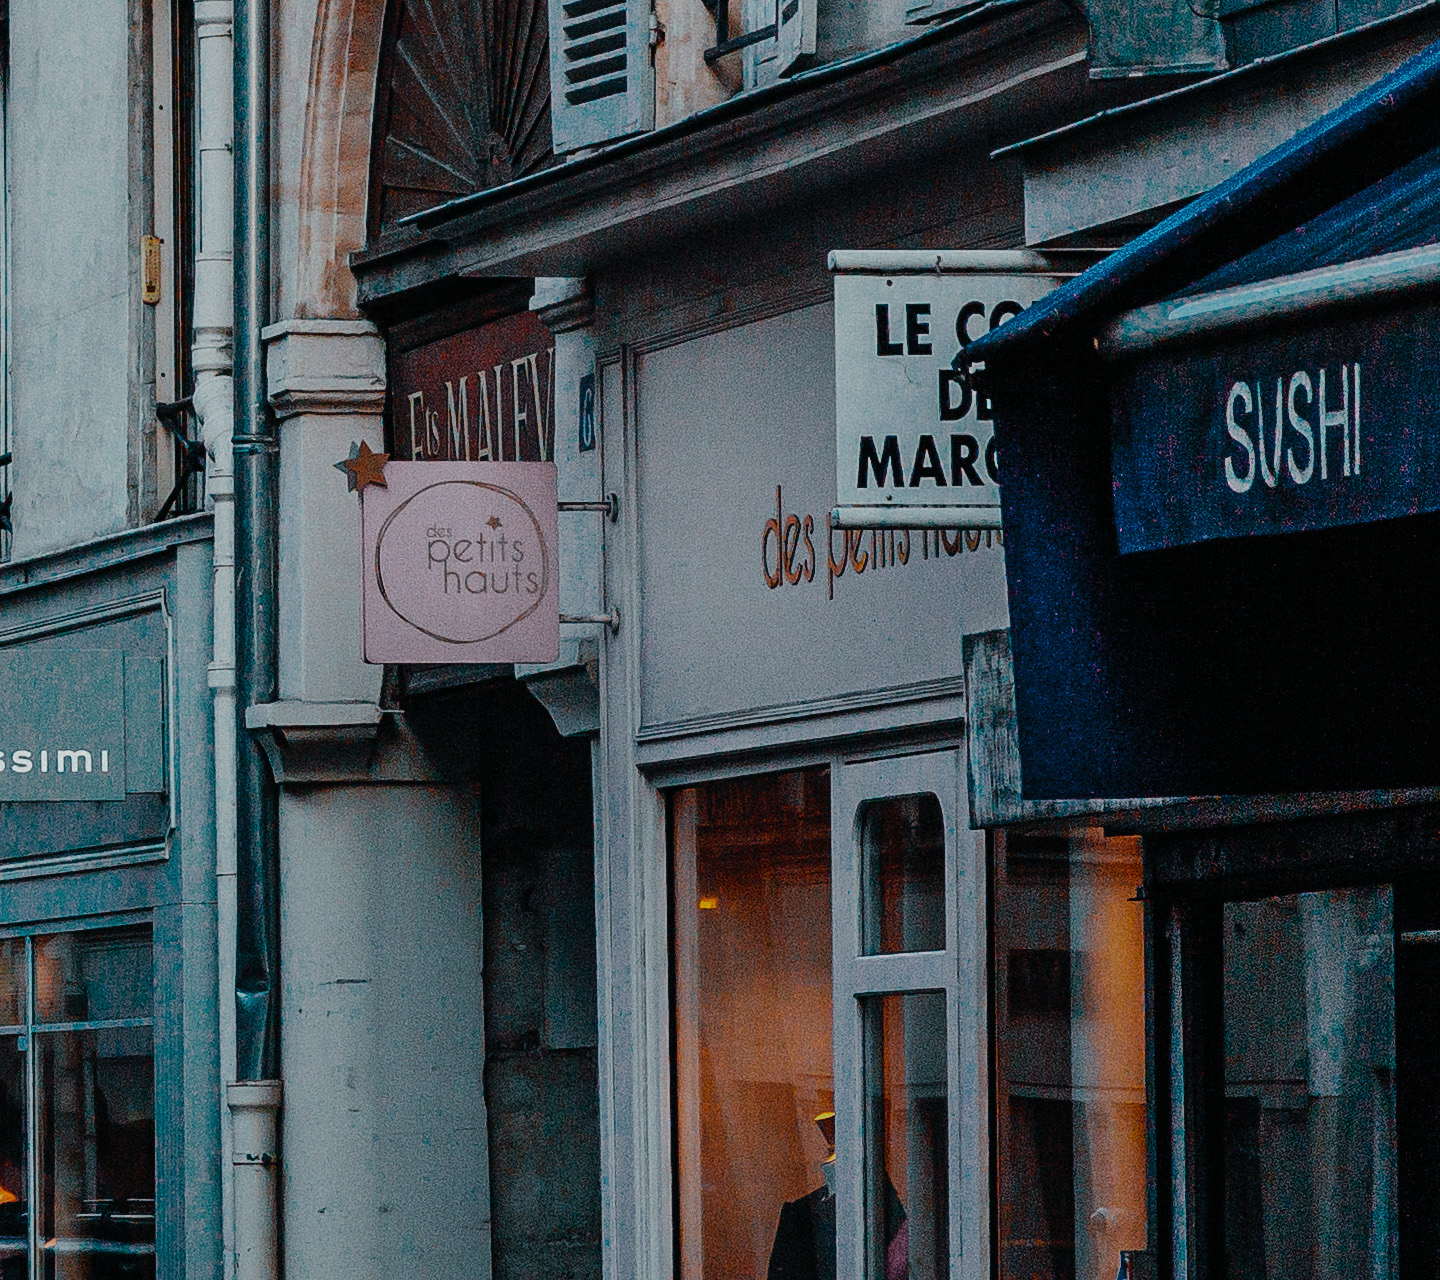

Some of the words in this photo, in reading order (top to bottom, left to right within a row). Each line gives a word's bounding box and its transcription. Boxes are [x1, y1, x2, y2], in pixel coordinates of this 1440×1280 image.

[875, 303, 933, 356] LE
[1224, 362, 1361, 494] SUSHI
[426, 523, 453, 538] des
[428, 532, 525, 570] petits
[761, 485, 816, 589] des
[443, 558, 540, 595] hauts
